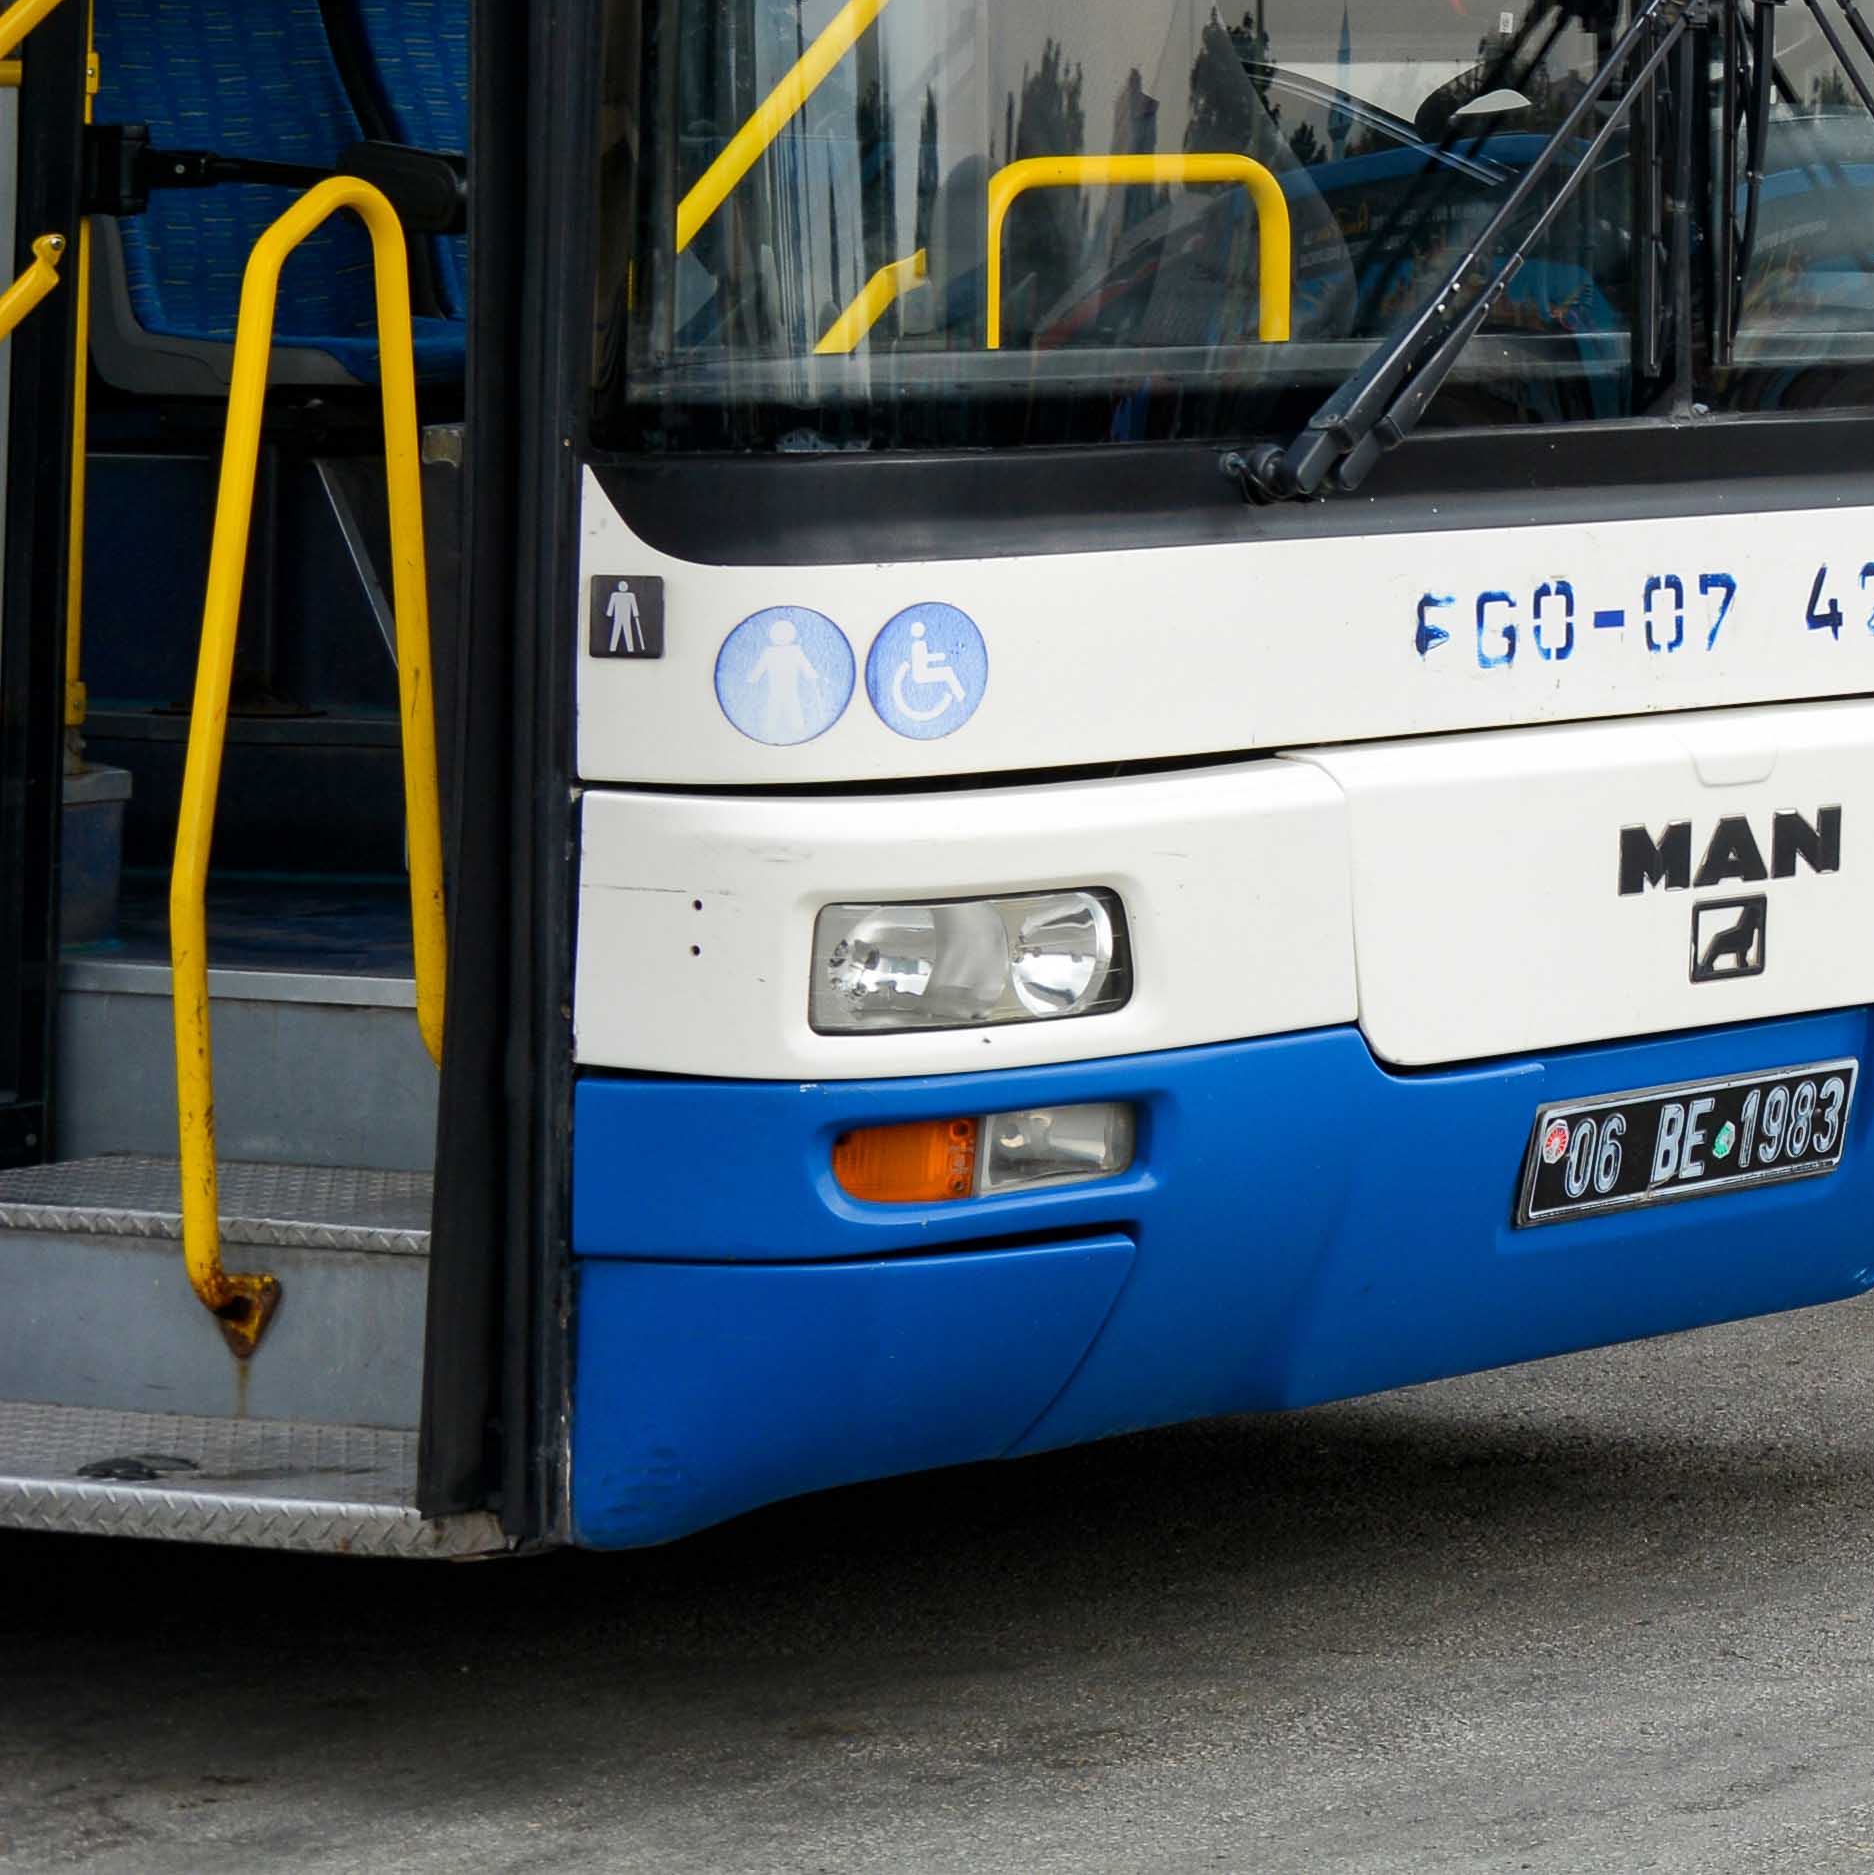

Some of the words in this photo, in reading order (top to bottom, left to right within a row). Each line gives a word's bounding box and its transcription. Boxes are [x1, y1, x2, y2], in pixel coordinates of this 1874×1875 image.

[1617, 804, 1843, 896] MAN
[1565, 1111, 1626, 1199] 06
[1650, 1096, 1715, 1181] BE
[1737, 1076, 1845, 1168] 1983
